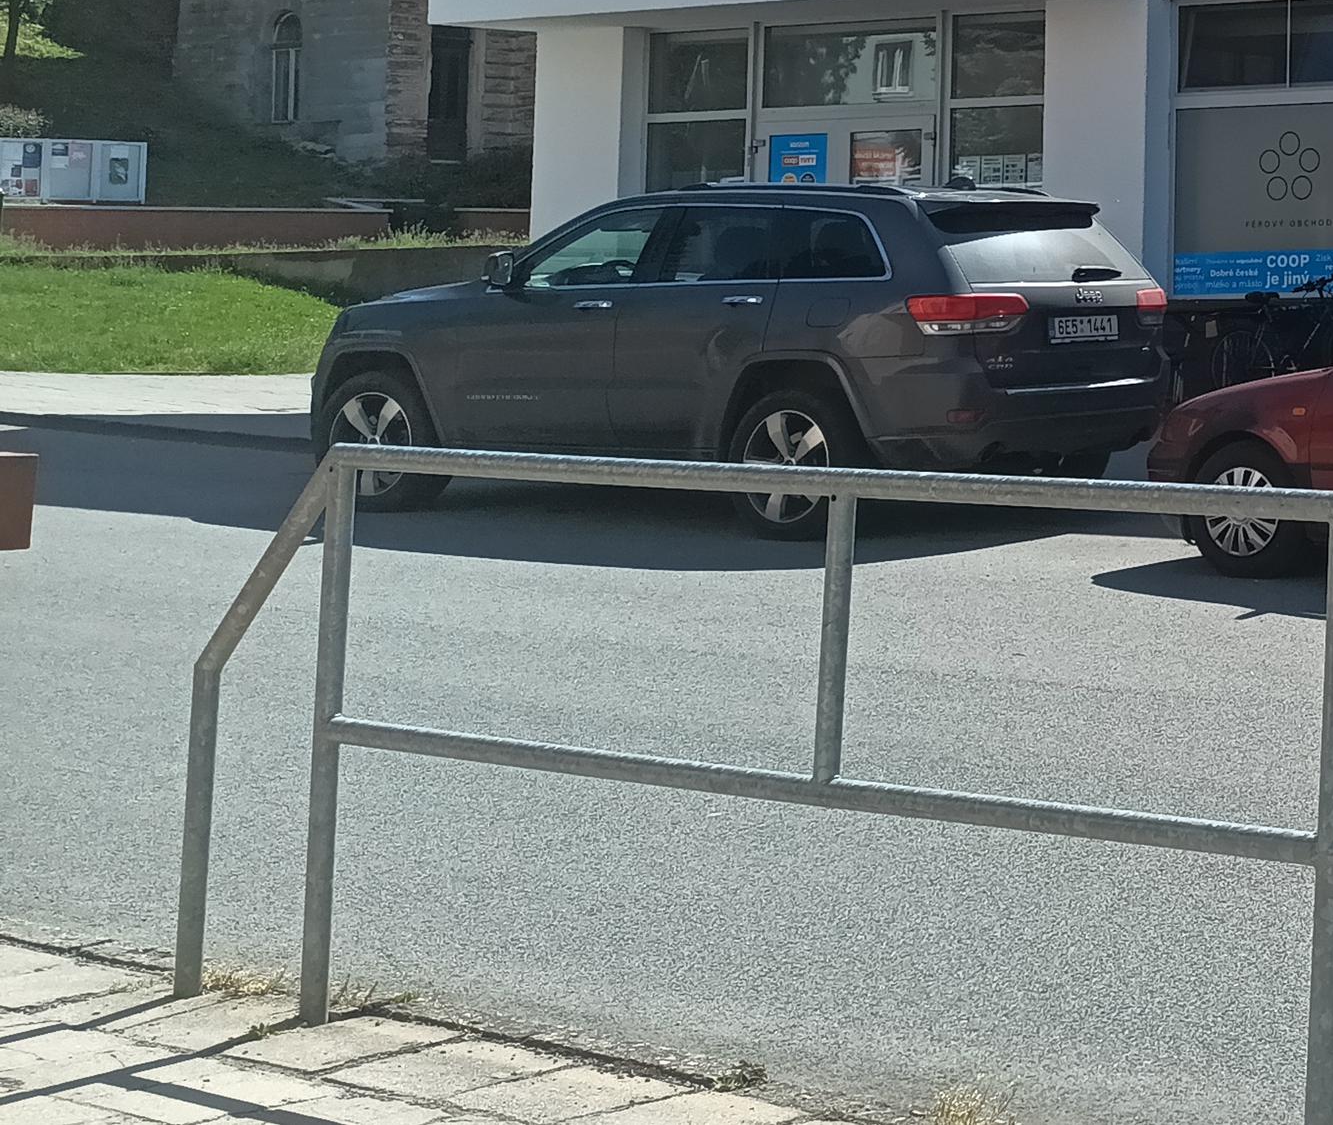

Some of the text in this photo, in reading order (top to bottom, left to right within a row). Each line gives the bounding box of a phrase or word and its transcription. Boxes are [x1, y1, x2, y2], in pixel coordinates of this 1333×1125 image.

[1245, 218, 1332, 228] FÉROVÝ OBCHOD
[1266, 254, 1310, 268] COOP
[1175, 266, 1201, 274] artnery
[1210, 268, 1259, 277] Dobré české
[1265, 269, 1310, 288] je jiný
[1076, 288, 1102, 301] Jeep
[1058, 318, 1113, 334] 6E5 1441
